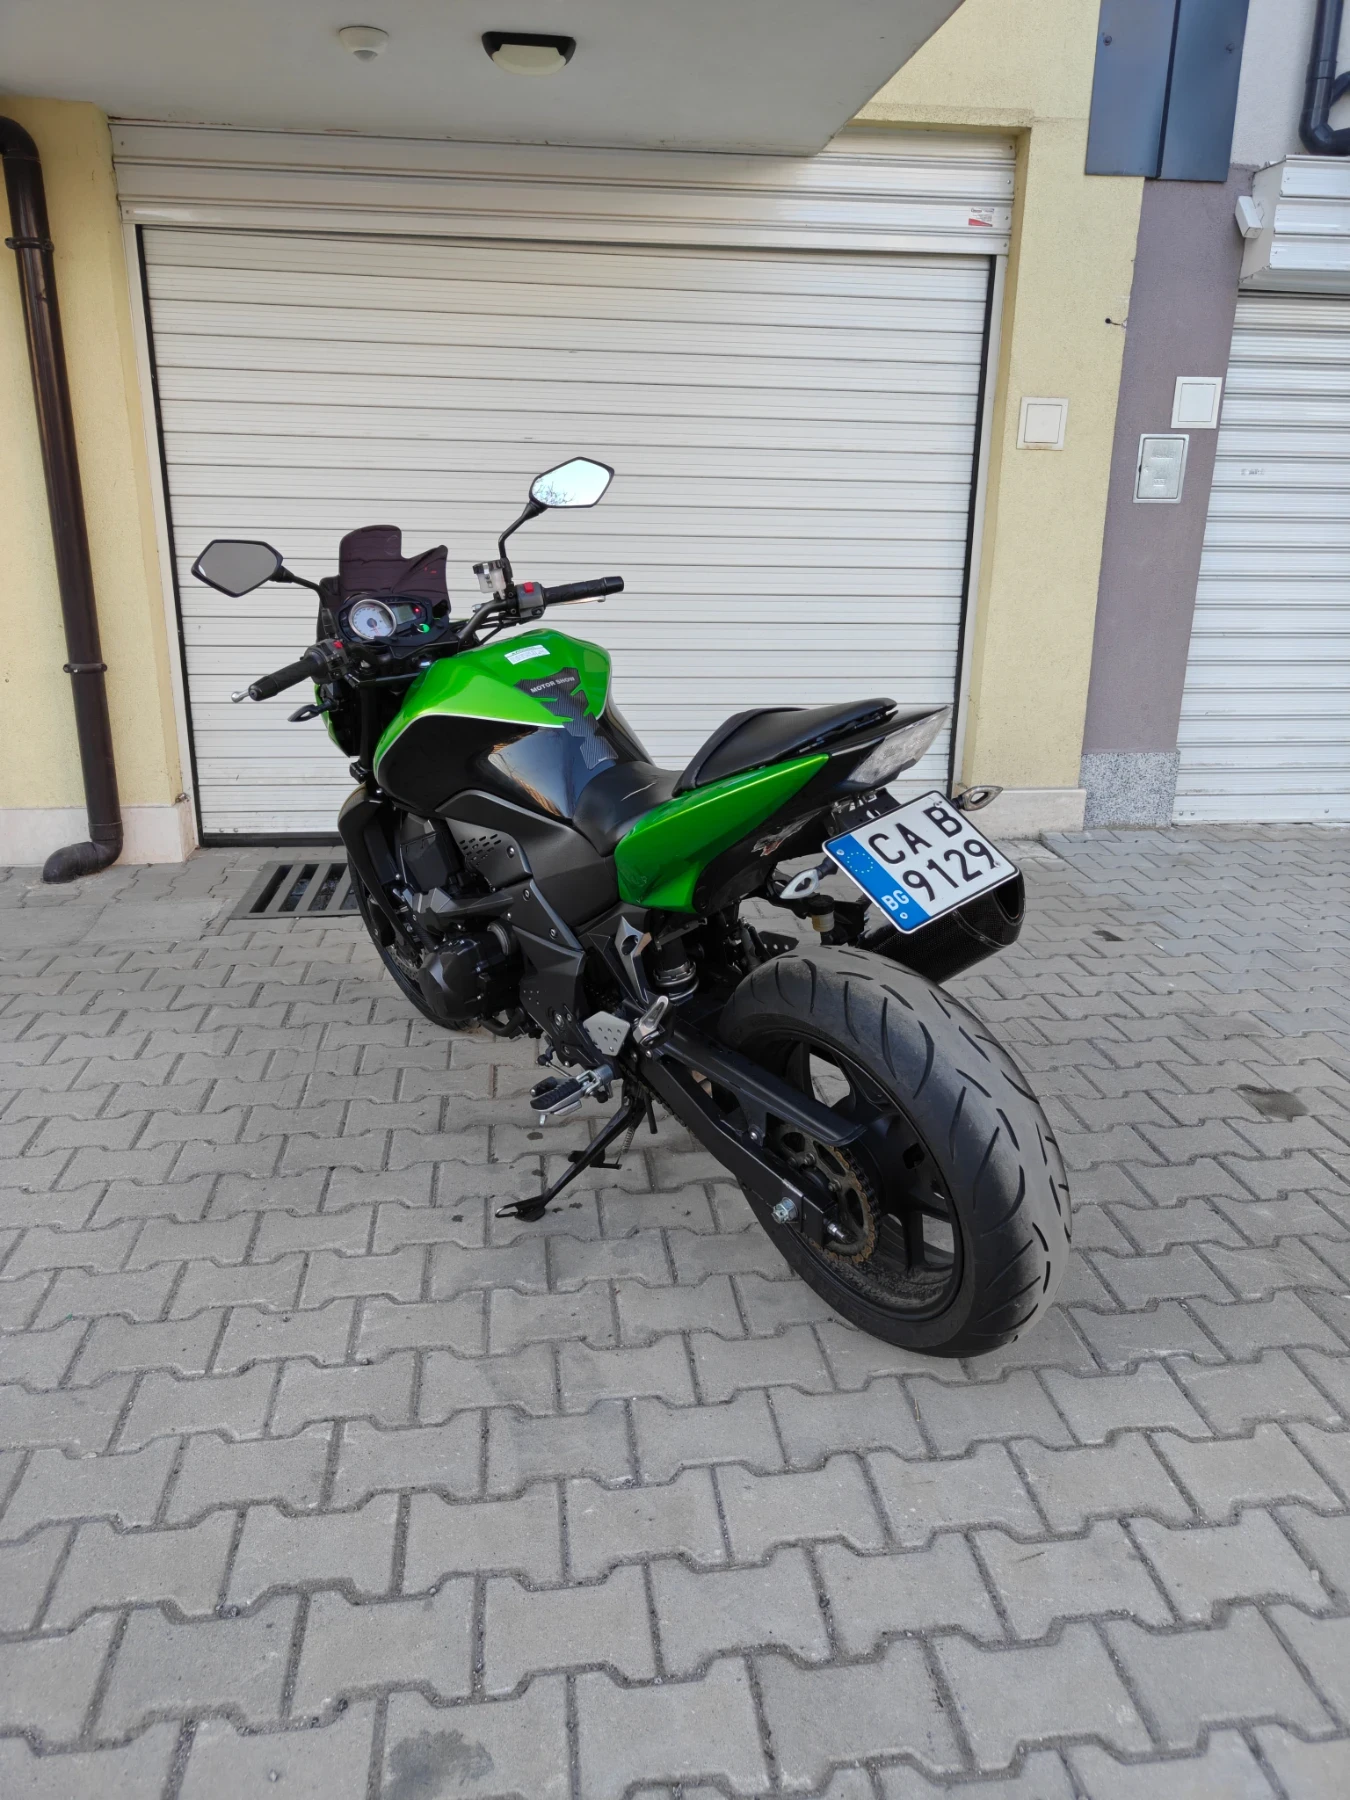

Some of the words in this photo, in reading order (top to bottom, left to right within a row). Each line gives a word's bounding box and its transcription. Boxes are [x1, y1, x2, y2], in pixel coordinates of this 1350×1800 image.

[530, 681, 556, 693] MOTOR
[555, 676, 575, 685] SHOW
[868, 823, 932, 864] CA
[922, 806, 963, 838] B
[902, 839, 996, 902] 9129
[881, 890, 910, 911] BG
